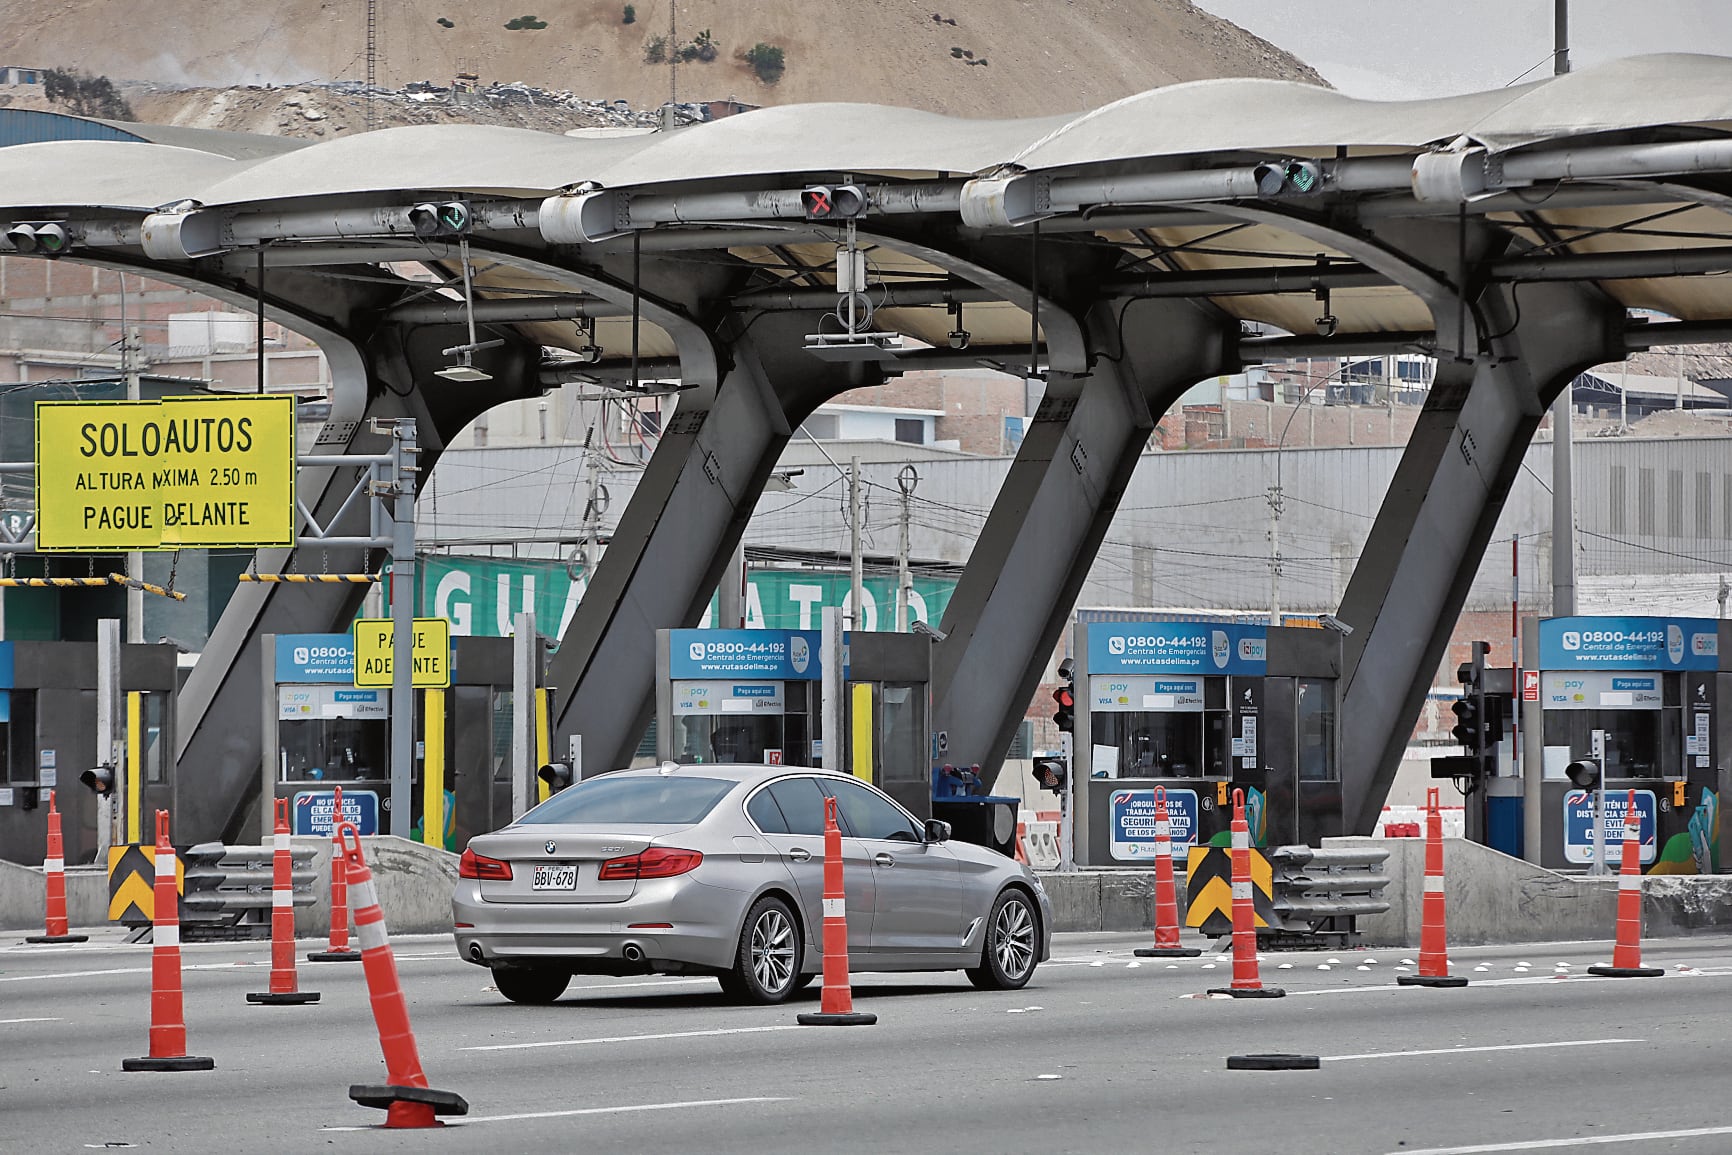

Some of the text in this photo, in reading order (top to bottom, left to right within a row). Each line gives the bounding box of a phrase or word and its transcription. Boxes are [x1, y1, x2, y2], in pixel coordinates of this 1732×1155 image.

[80, 417, 252, 457] SOLO AUTOS
[75, 468, 257, 490] ALTURA MXIMA 2.50 m
[84, 502, 250, 529] PAGUE DELANTE
[378, 633, 425, 648] PAE
[1582, 631, 1664, 642] 0800-44-192
[1127, 637, 1206, 647] 0800-44-192
[707, 643, 784, 652] 0800-44-192
[1168, 648, 1206, 656] Emergencias
[1626, 643, 1663, 652] Emergenc
[365, 657, 440, 674] ADENTE
[1121, 658, 1200, 666] www.rutasdelima.pe
[1130, 801, 1174, 809] ¡ORGULLOS
[1588, 800, 1620, 808] MTÉN
[1576, 810, 1646, 818] DISTCIA SEURA
[313, 816, 360, 824] EMERCIA,
[1123, 818, 1188, 826] SEGURI VIAL
[1605, 820, 1625, 828] EVIT
[1588, 830, 1625, 838] AIDEN
[534, 872, 574, 886] BBV-678
